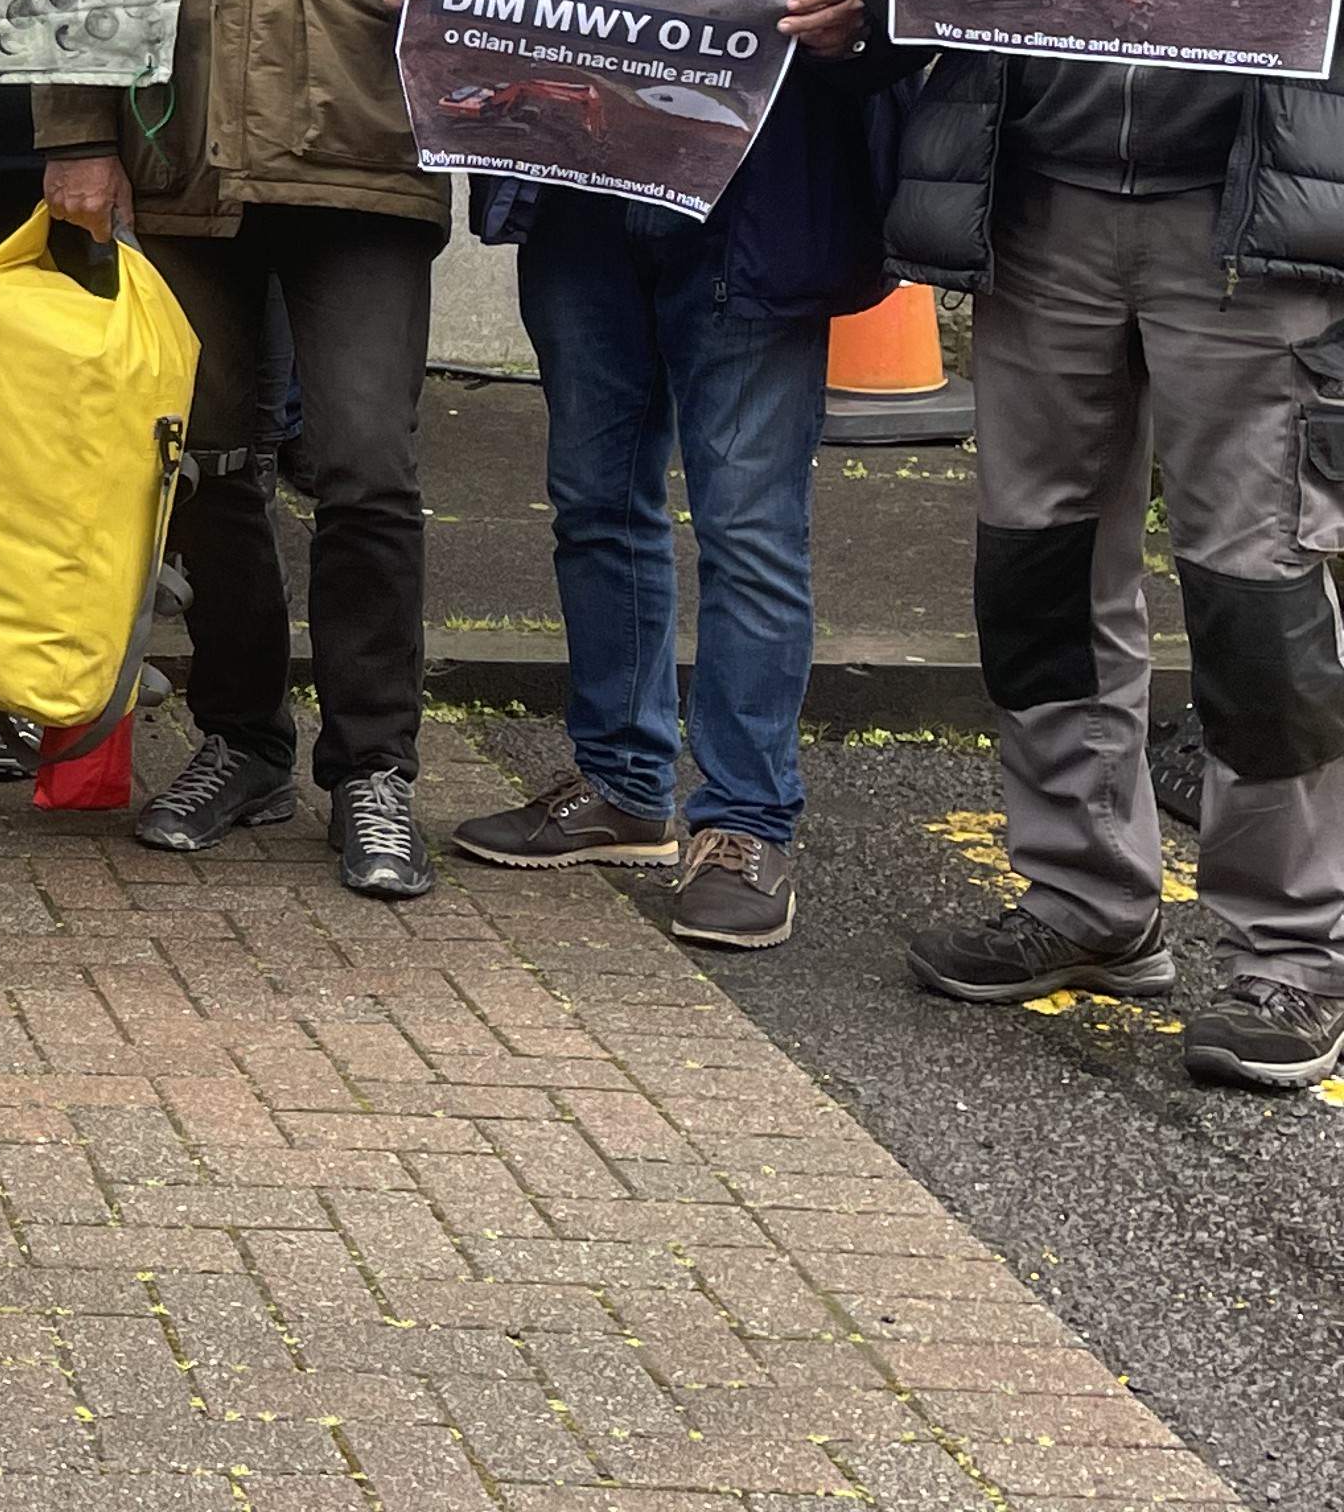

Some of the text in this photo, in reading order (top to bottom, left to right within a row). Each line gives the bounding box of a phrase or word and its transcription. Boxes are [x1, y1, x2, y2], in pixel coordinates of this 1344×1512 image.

[444, 29, 732, 89] o Glan Lash nac unlle arall
[658, 19, 690, 51] O
[698, 25, 760, 59] LO
[934, 22, 1283, 67] We are in a climate and nature emergency.
[422, 149, 465, 167] Rydym
[467, 155, 513, 169] mewn
[515, 160, 588, 185] argyfwng
[590, 171, 665, 198] hinsawdd
[665, 189, 675, 200] a
